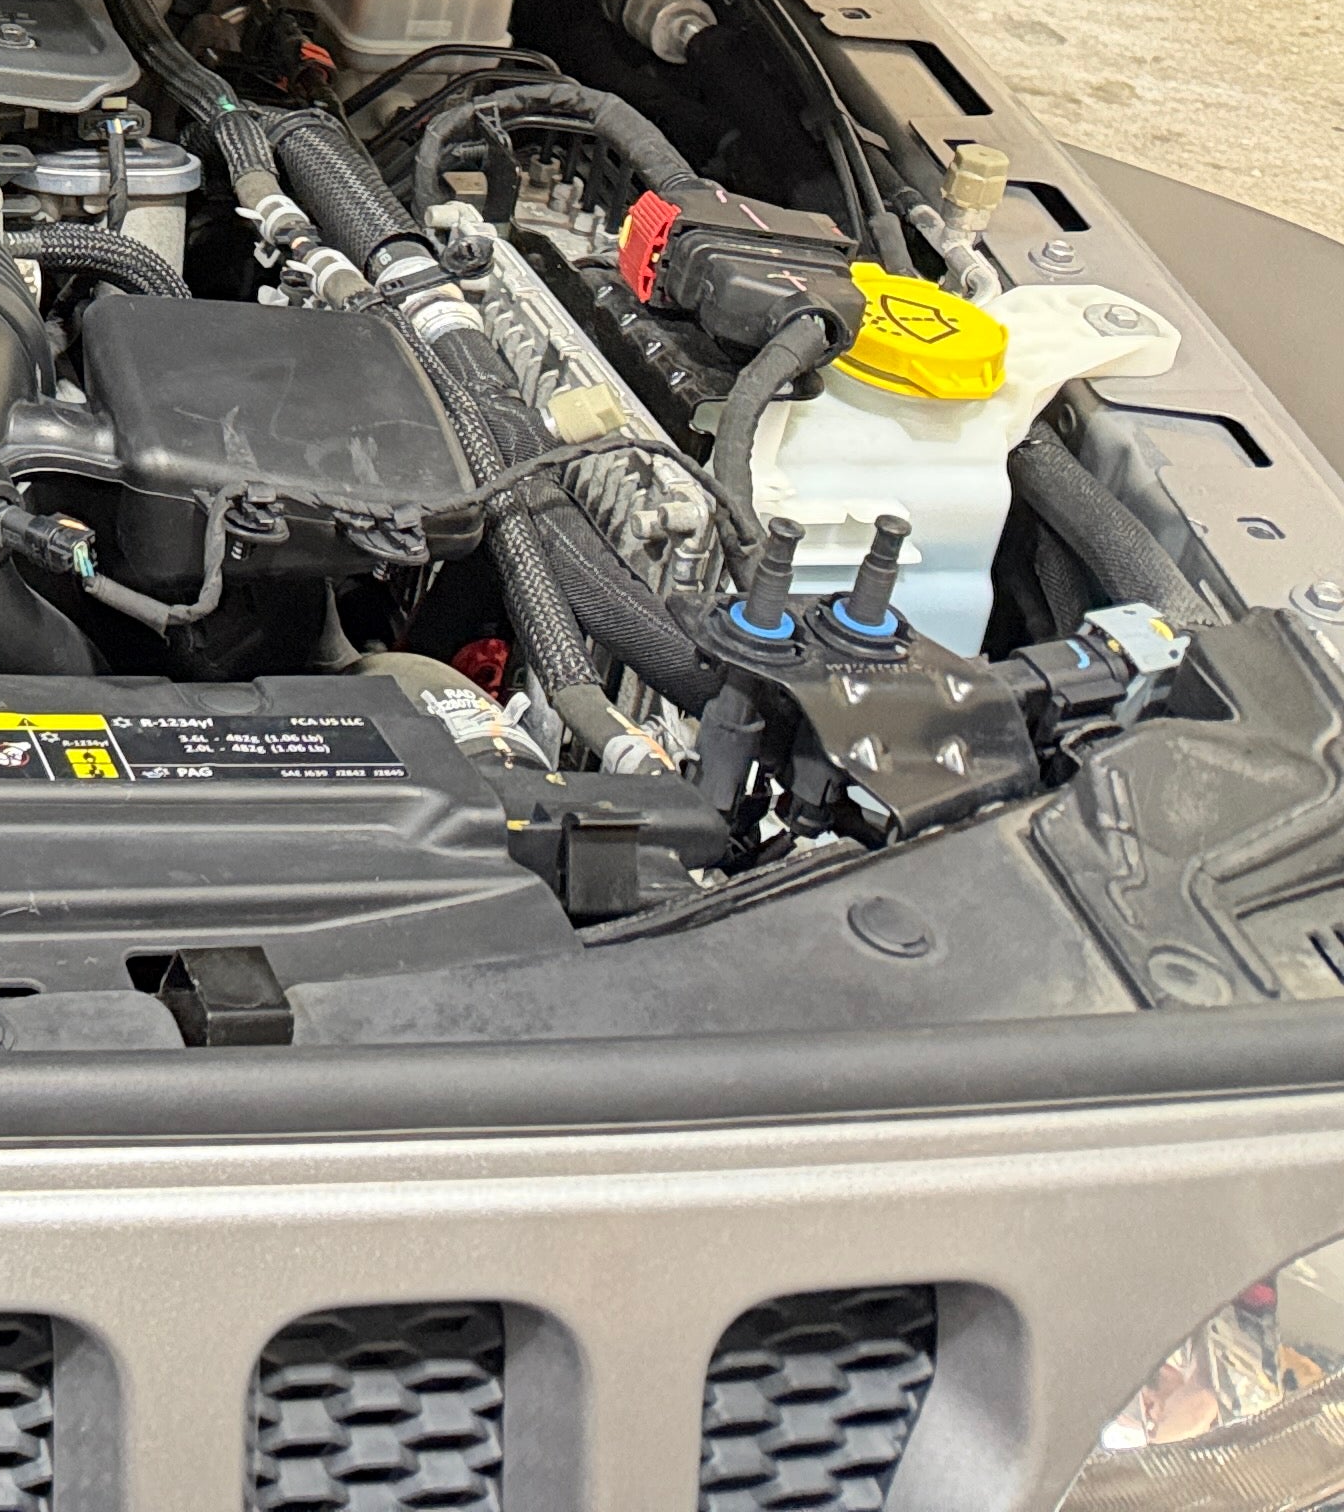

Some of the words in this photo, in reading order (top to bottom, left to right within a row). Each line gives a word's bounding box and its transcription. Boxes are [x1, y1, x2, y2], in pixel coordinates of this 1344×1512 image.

[444, 688, 477, 700] RAD
[139, 717, 213, 729] R-1234yf
[290, 717, 318, 727] FCA
[319, 717, 339, 727] US
[339, 717, 365, 727] LLC
[183, 745, 214, 754] 2.0L
[176, 767, 213, 778] PAG
